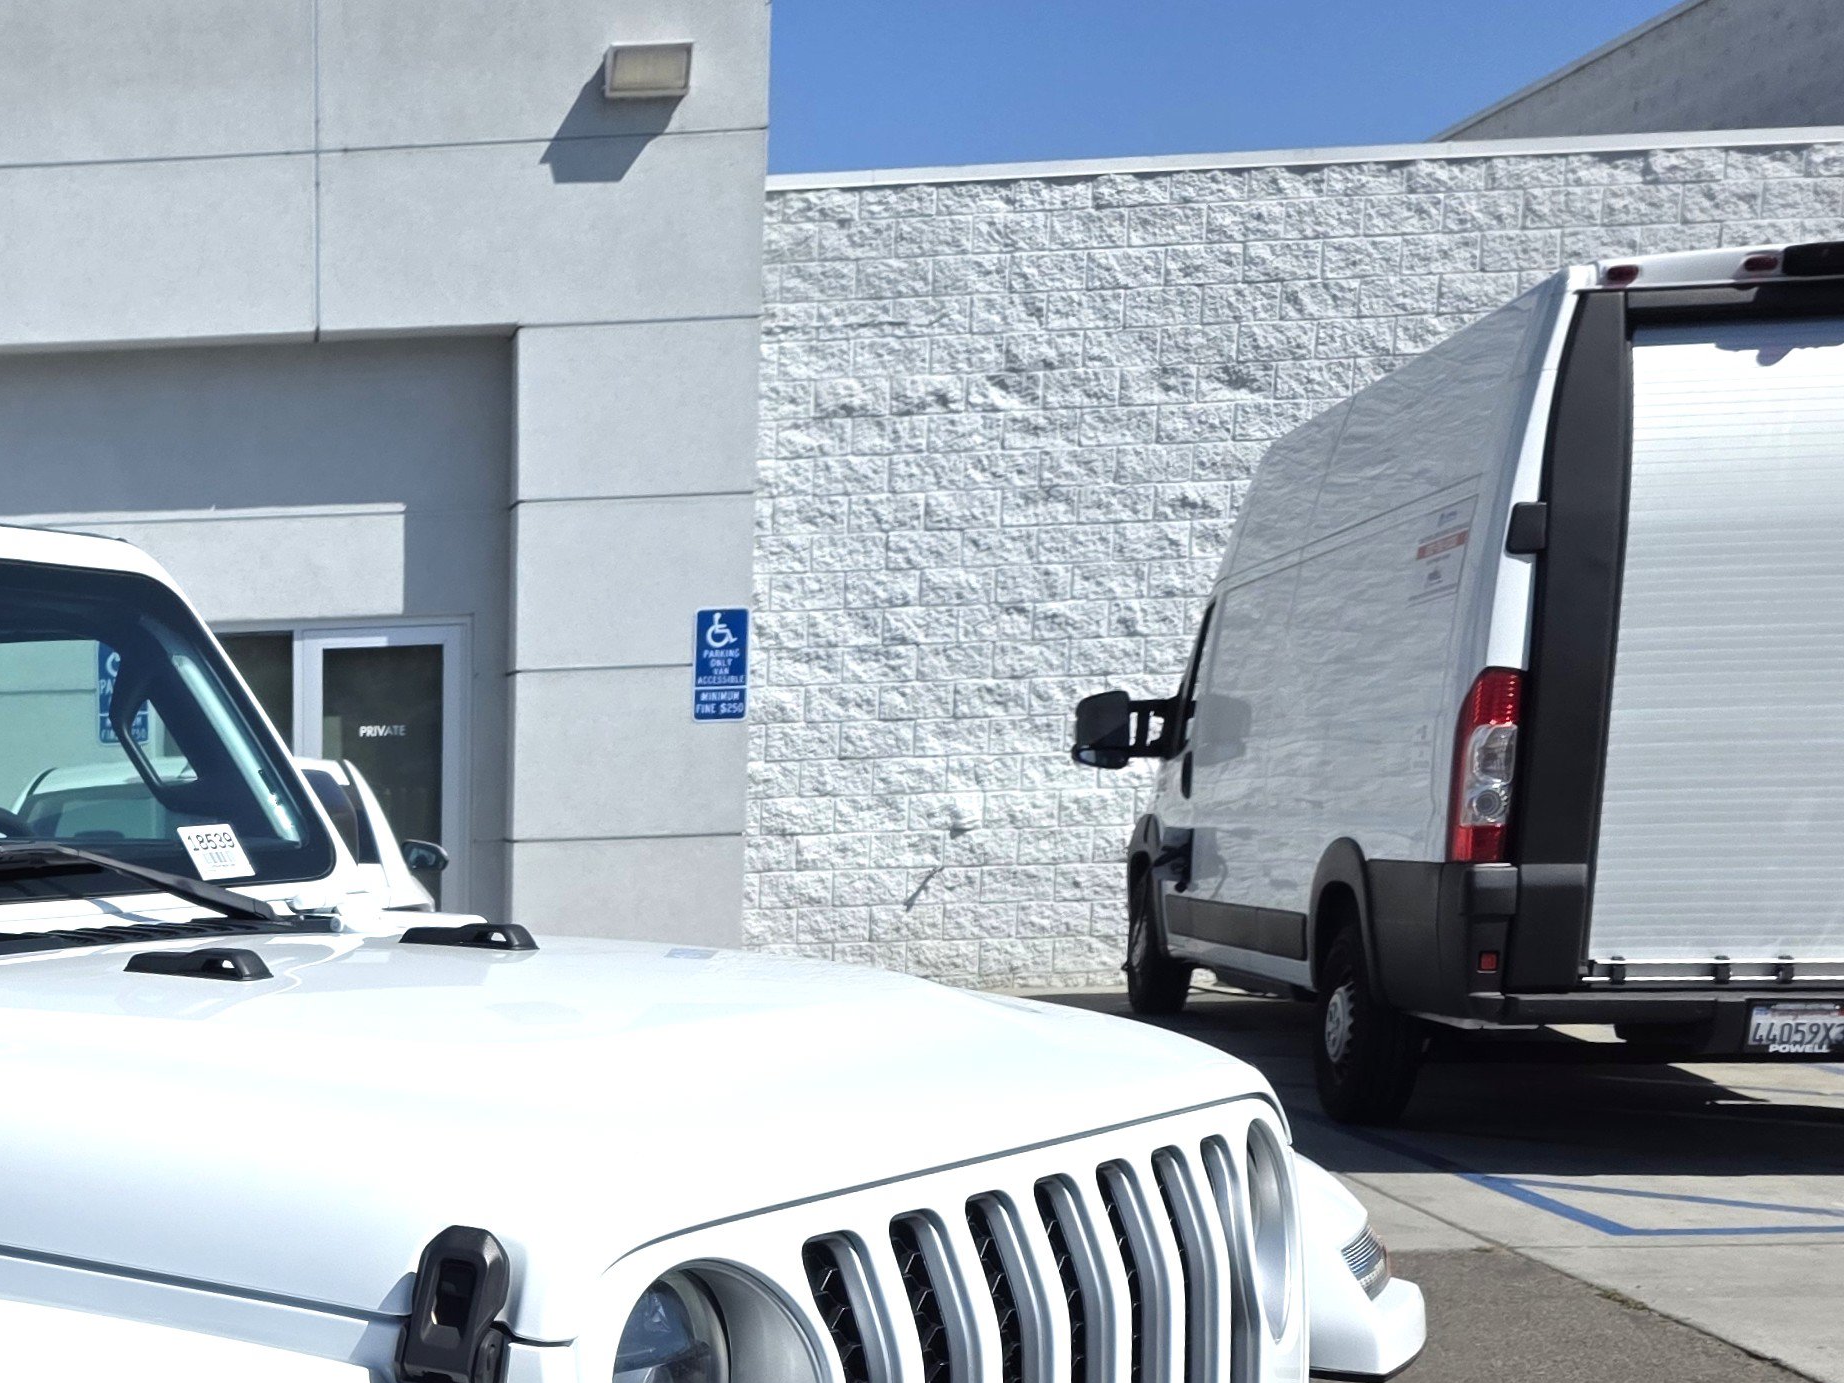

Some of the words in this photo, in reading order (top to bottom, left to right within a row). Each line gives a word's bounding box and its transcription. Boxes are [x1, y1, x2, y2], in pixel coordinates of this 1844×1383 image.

[703, 648, 740, 659] PARKING
[710, 658, 733, 667] ONLY
[712, 667, 730, 675] VAN
[697, 675, 745, 685] ACCESSIBLE
[700, 691, 740, 702] MINIMUM
[696, 703, 717, 714] FINE
[720, 702, 744, 714] $250
[359, 725, 407, 737] PRIVATE
[187, 831, 236, 852] 18539
[1768, 1043, 1831, 1053] POWELL
